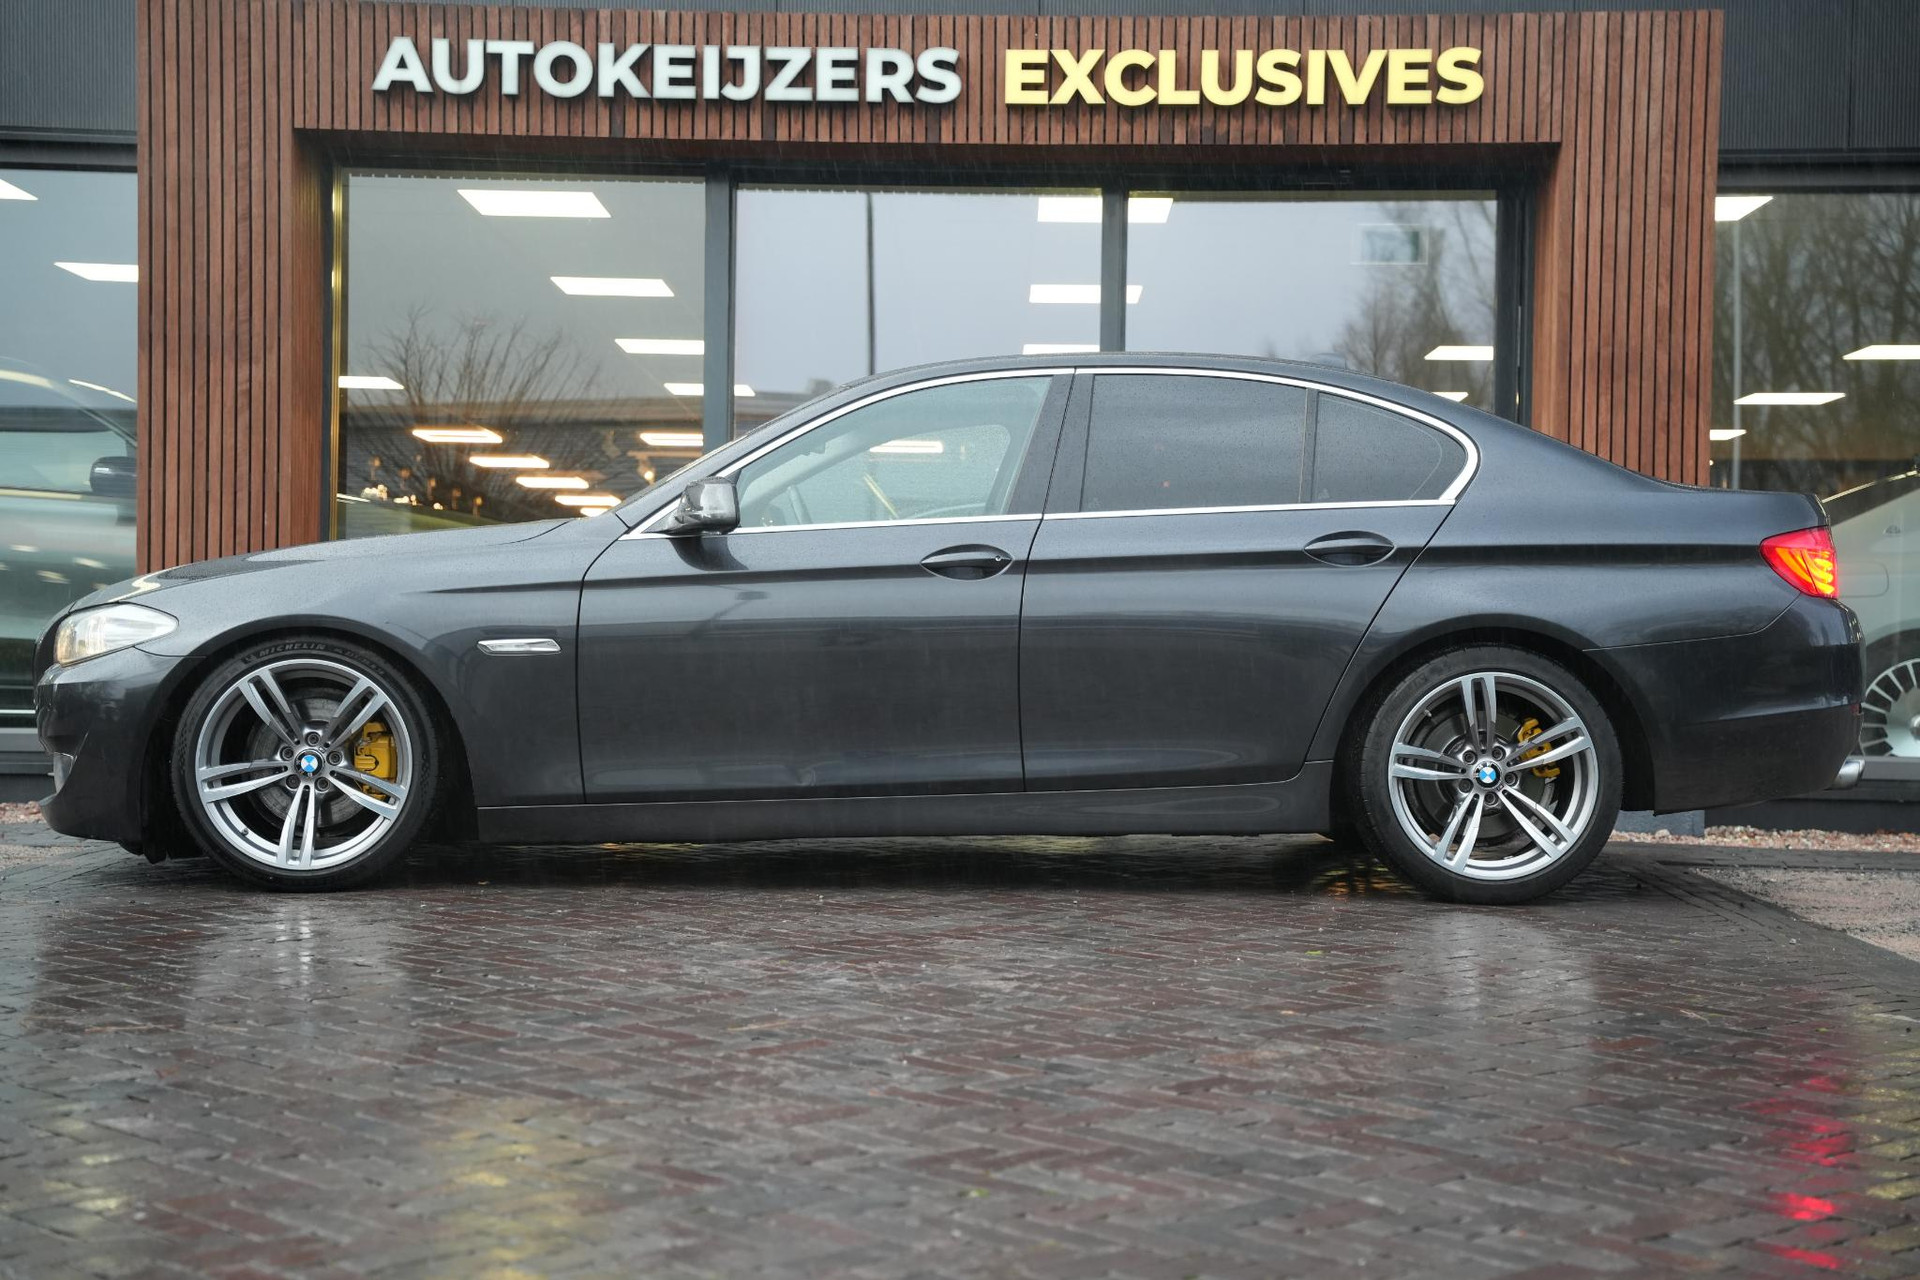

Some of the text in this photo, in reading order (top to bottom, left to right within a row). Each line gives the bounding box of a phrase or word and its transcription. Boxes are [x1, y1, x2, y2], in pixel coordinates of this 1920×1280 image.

[372, 36, 1485, 106] AUTOKEIJZERS EXCLUSIVES
[259, 642, 327, 657] MICHELIN
